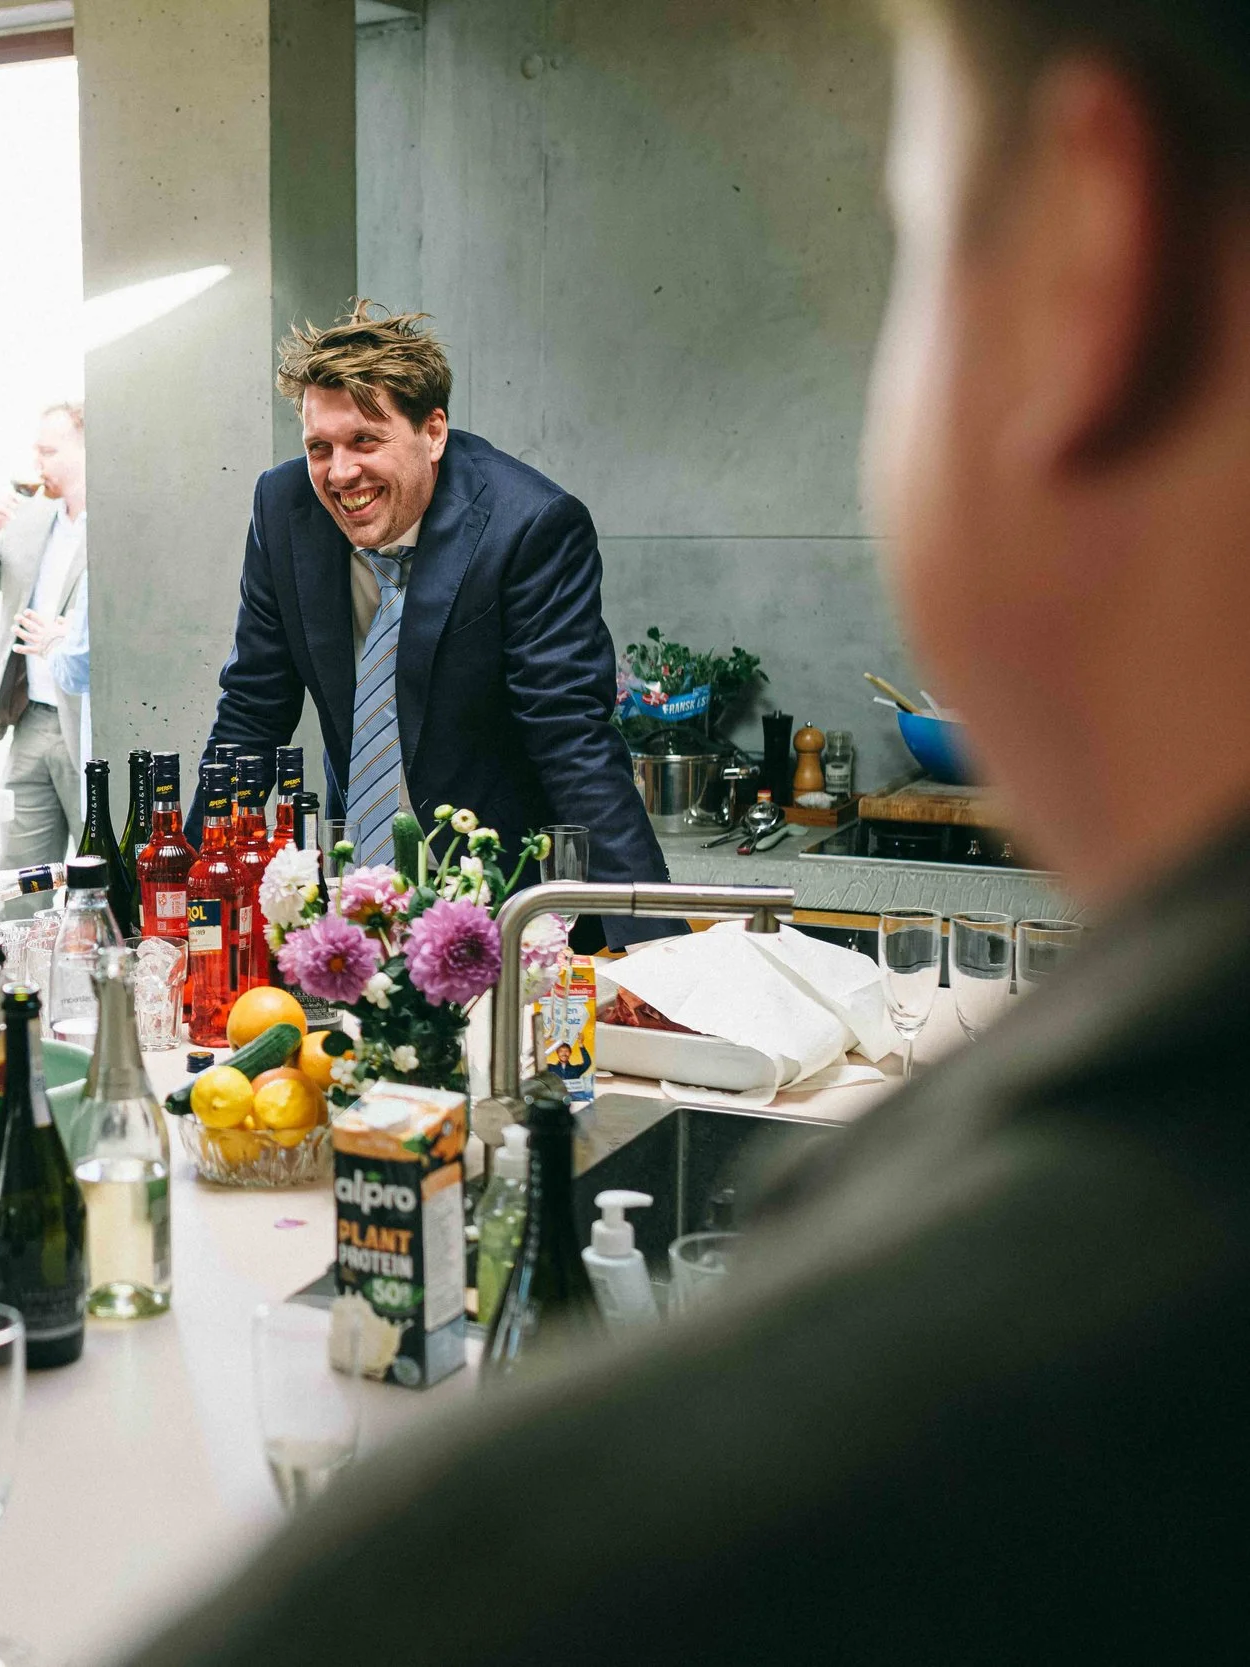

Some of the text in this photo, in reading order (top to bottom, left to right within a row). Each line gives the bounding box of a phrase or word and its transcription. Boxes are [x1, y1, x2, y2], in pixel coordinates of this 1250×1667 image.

[662, 700, 695, 714] FRANSK
[335, 1169, 416, 1215] alpro
[339, 1219, 413, 1256] PLANT
[339, 1243, 413, 1279] PROTEIN
